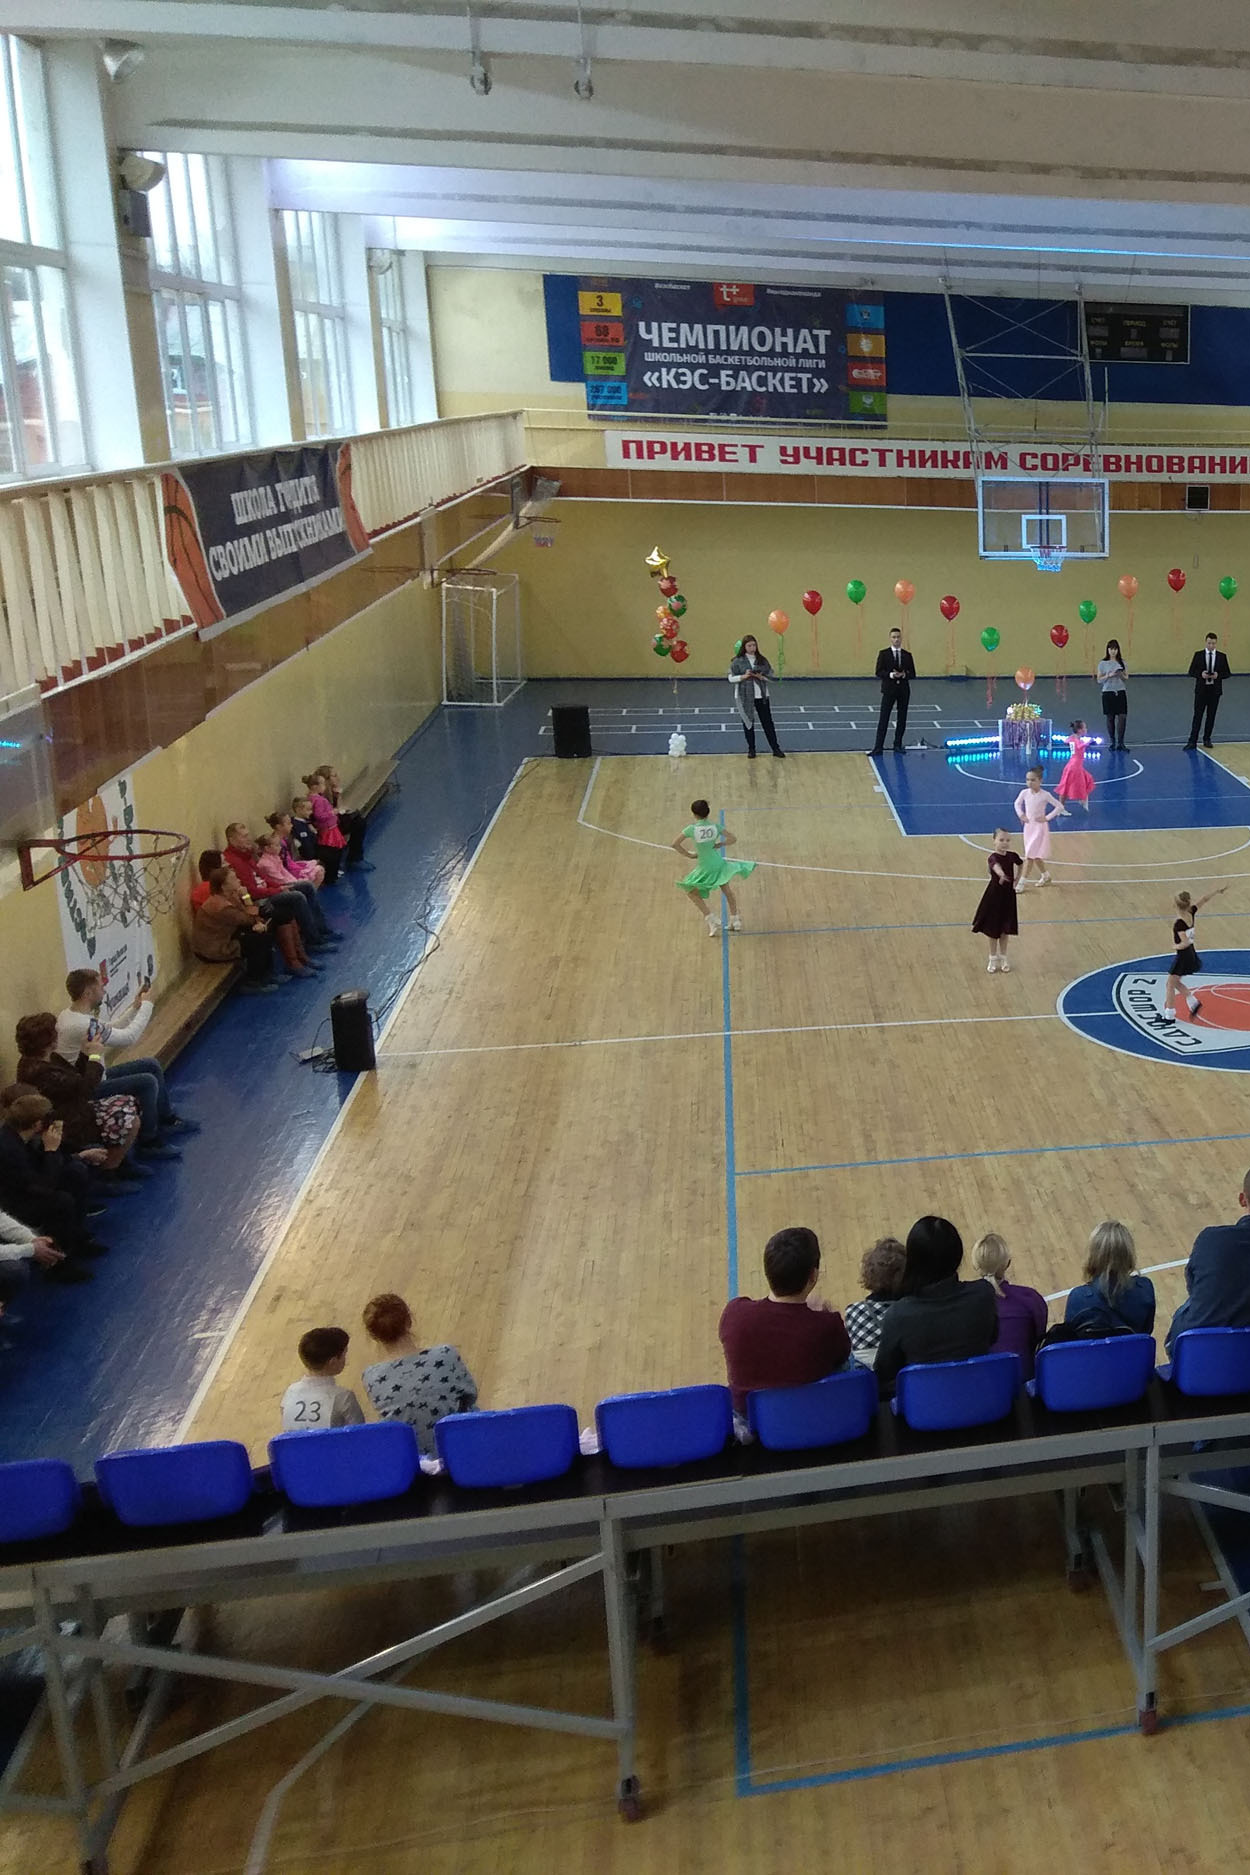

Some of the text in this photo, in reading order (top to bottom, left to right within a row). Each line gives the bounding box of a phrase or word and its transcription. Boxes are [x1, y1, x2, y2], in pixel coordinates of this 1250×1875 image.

[596, 295, 604, 307] 3
[638, 321, 831, 354] ЧЕМПИОНАТ
[644, 351, 826, 368] ШКОЛЬНОЙ БАСКЕТБОЛЬНОЙ ЛИГИ
[643, 367, 829, 394] «КЭС-БАСКЕТ»
[622, 439, 764, 463] ПРИВЕТ
[779, 445, 1008, 471] УЧАСТНИКАМ
[230, 485, 278, 526] ШКОЛА
[209, 532, 270, 581] СВОИМИ
[700, 828, 714, 839] 20
[294, 1400, 321, 1422] 23
